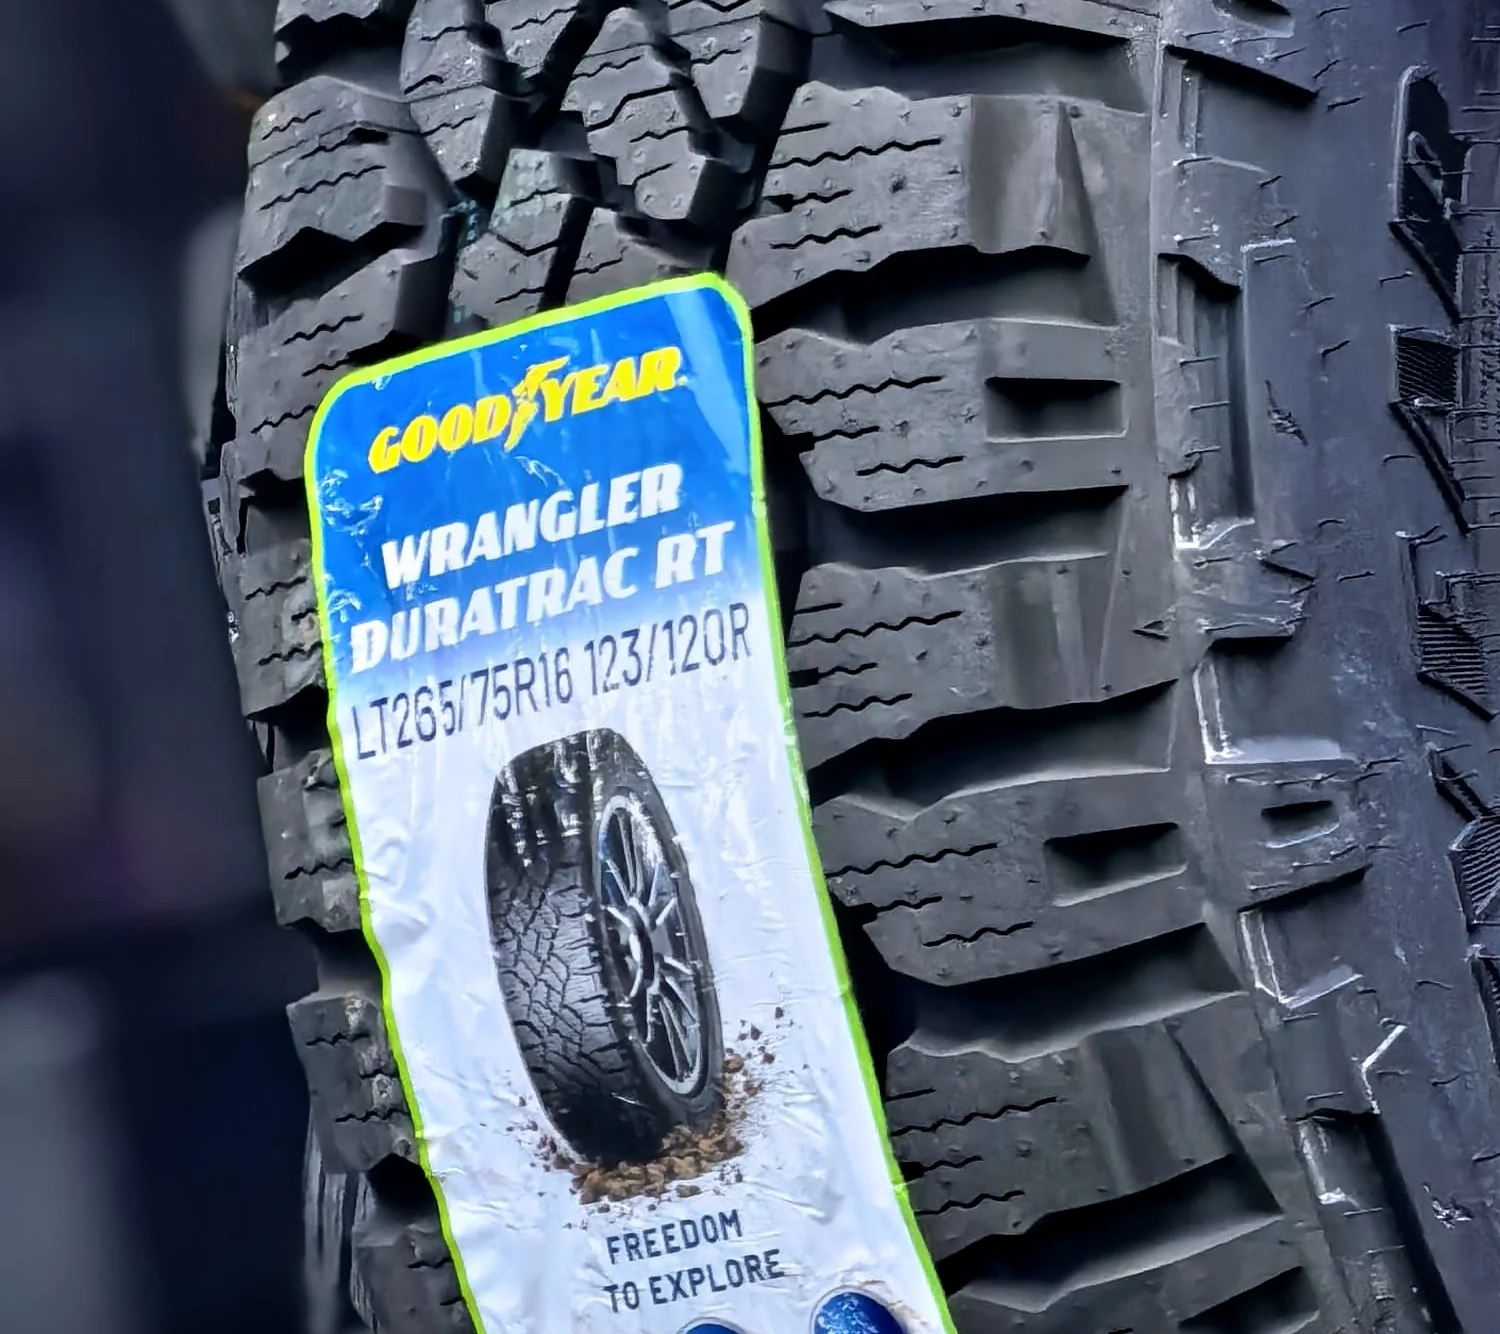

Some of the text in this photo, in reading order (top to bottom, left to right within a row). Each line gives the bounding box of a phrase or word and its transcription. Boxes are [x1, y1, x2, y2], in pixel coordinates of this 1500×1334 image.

[367, 346, 684, 473] GOODYEAR
[381, 463, 684, 590] WRANGLER
[350, 521, 736, 673] DURATRAC RT
[350, 601, 752, 760] LT265/75R16 123/120R
[602, 1248, 786, 1314] TO EXPLORE
[606, 1209, 743, 1264] FREEDOM
